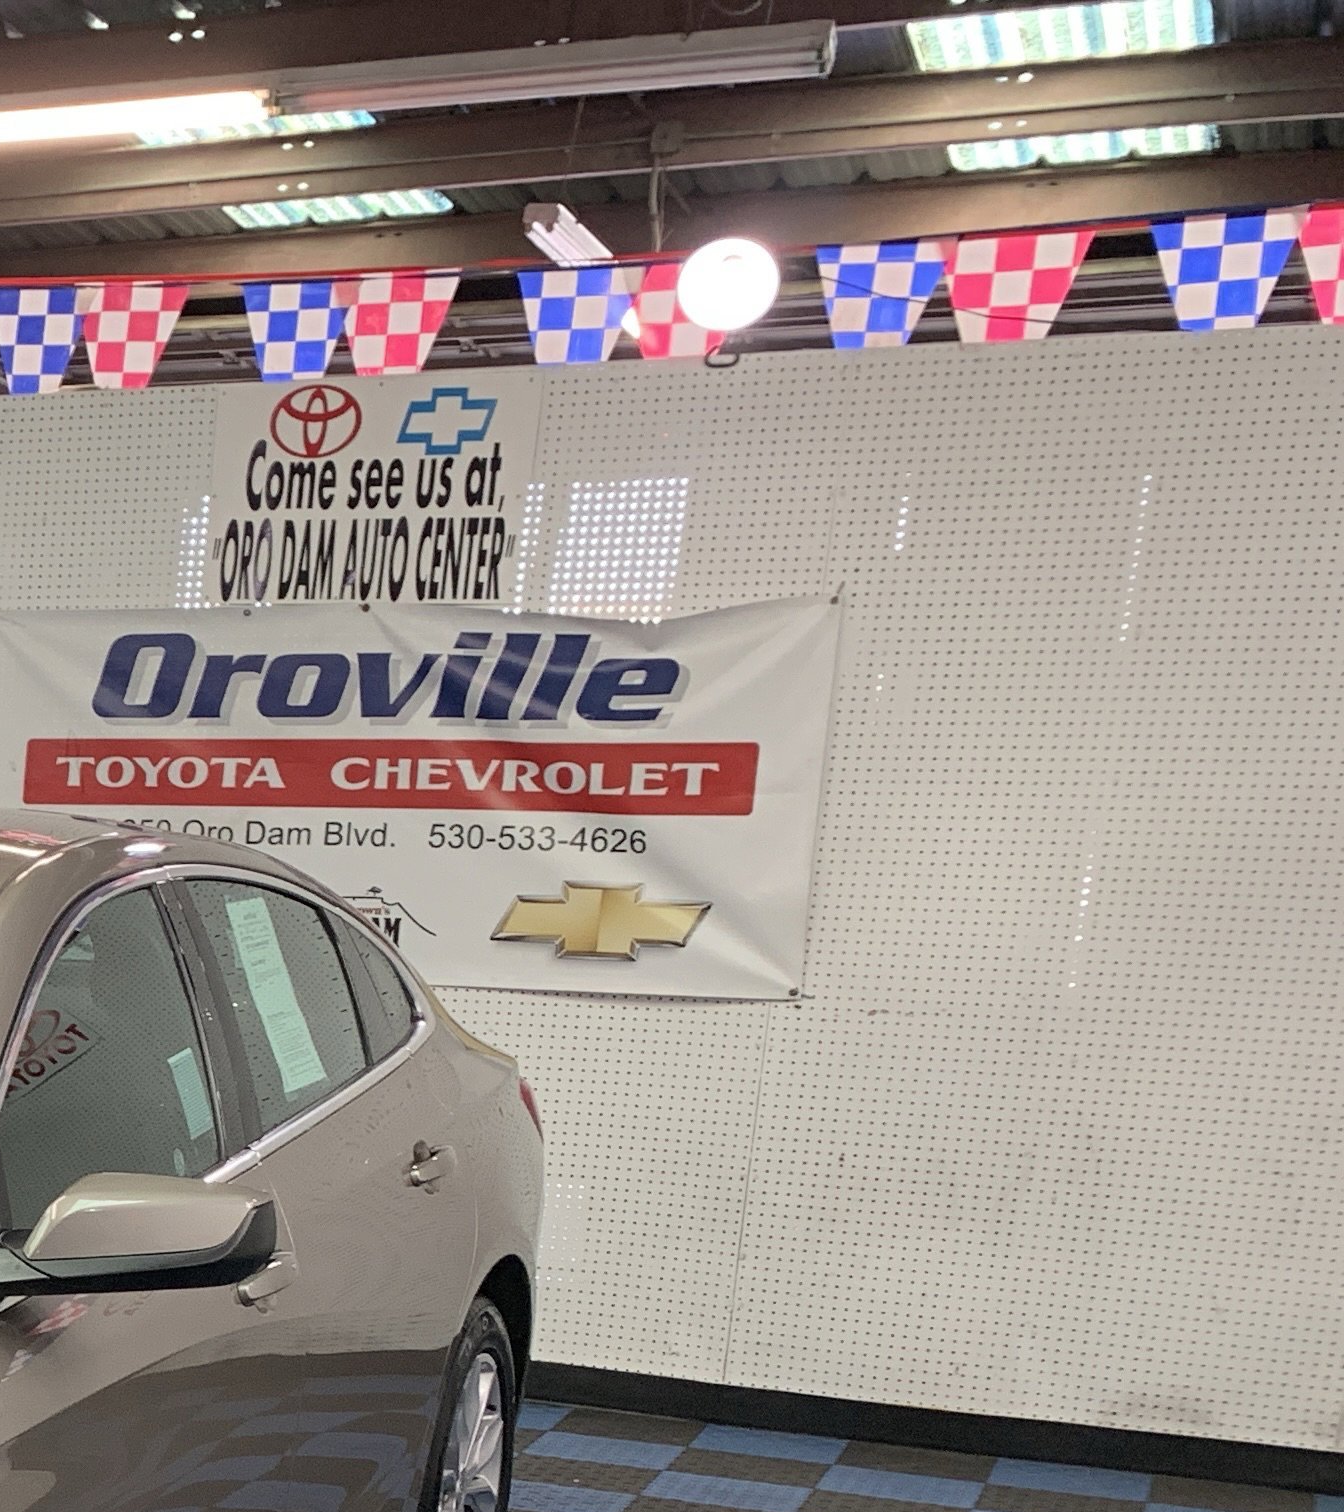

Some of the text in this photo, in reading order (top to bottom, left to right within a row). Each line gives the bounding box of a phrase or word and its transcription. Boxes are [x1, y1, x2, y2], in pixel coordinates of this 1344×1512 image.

[245, 438, 506, 513] Come see us at,
[277, 518, 337, 601] DAM
[339, 516, 410, 602] AUTO
[414, 516, 517, 602] CENTER"
[90, 630, 682, 723] Oroville
[55, 754, 721, 798] TOYOTA CHEVROLET
[245, 819, 312, 846] Dam
[323, 817, 397, 848] Blvd.
[427, 823, 648, 855] 530-533-4626
